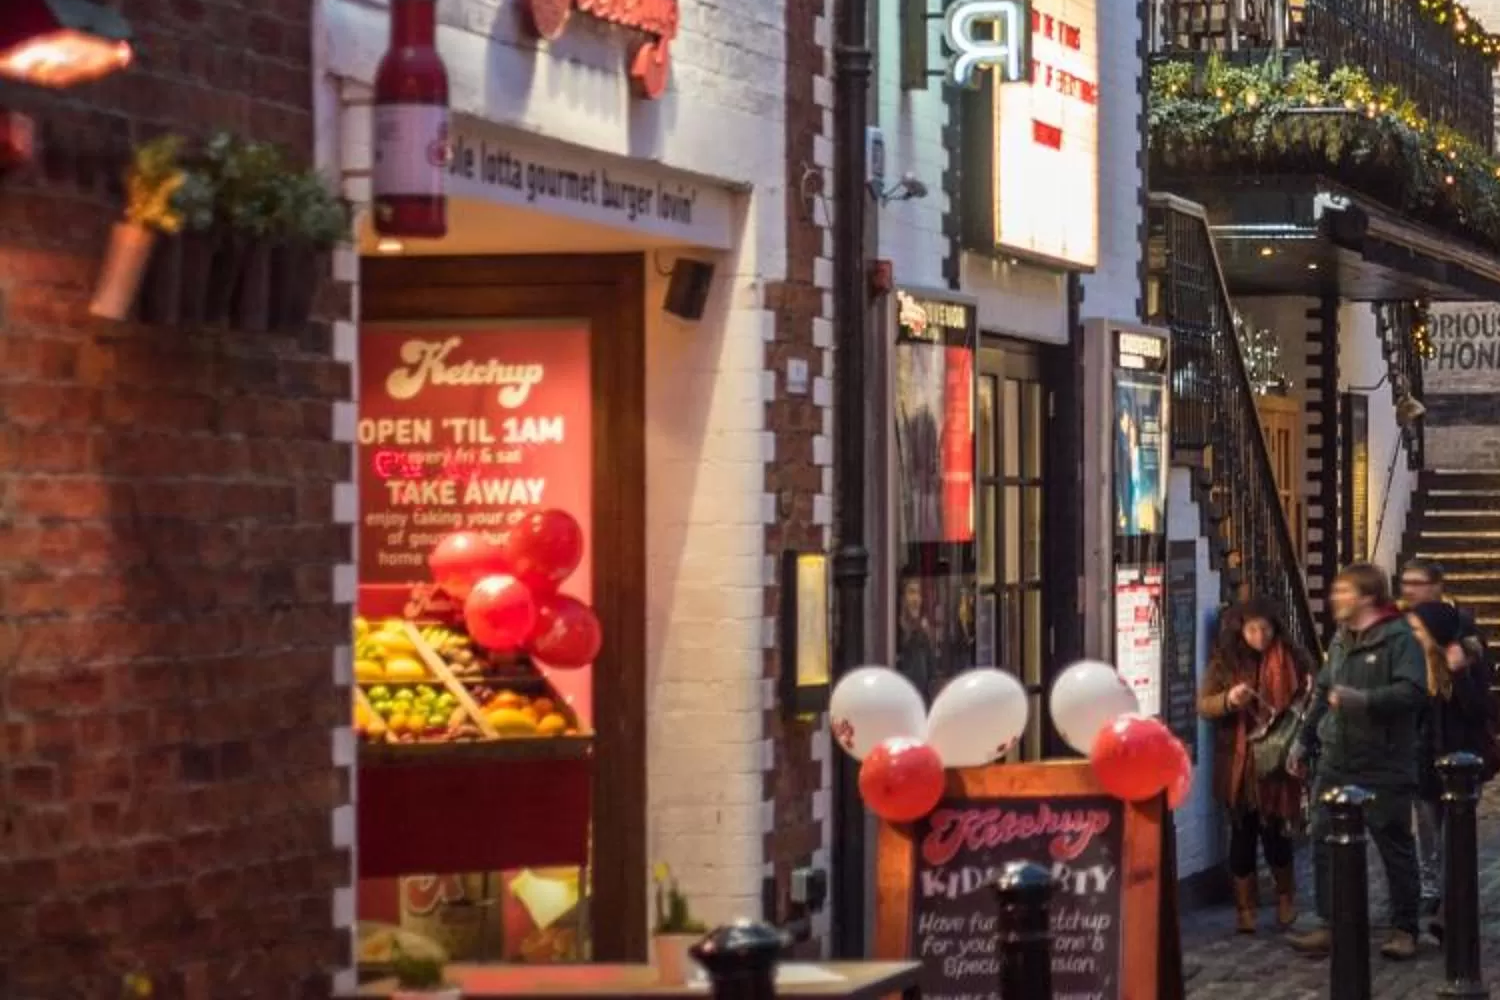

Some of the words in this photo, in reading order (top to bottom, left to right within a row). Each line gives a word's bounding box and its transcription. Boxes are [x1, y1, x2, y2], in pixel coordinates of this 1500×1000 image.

[481, 140, 522, 191] lotta
[528, 163, 598, 203] gourmet
[602, 168, 653, 221] burger
[386, 336, 544, 408] Ketchup
[358, 418, 431, 444] OPEN
[502, 416, 564, 443] 1AM
[385, 479, 457, 504] TAKE
[463, 478, 545, 504] AWAY
[365, 511, 408, 528] enjoy
[413, 509, 462, 528] taking
[467, 511, 503, 528] your
[378, 551, 422, 566] home
[923, 803, 1110, 865] Ketchup
[1053, 861, 1115, 896] RTY
[917, 910, 964, 935] Have
[921, 935, 953, 956] for
